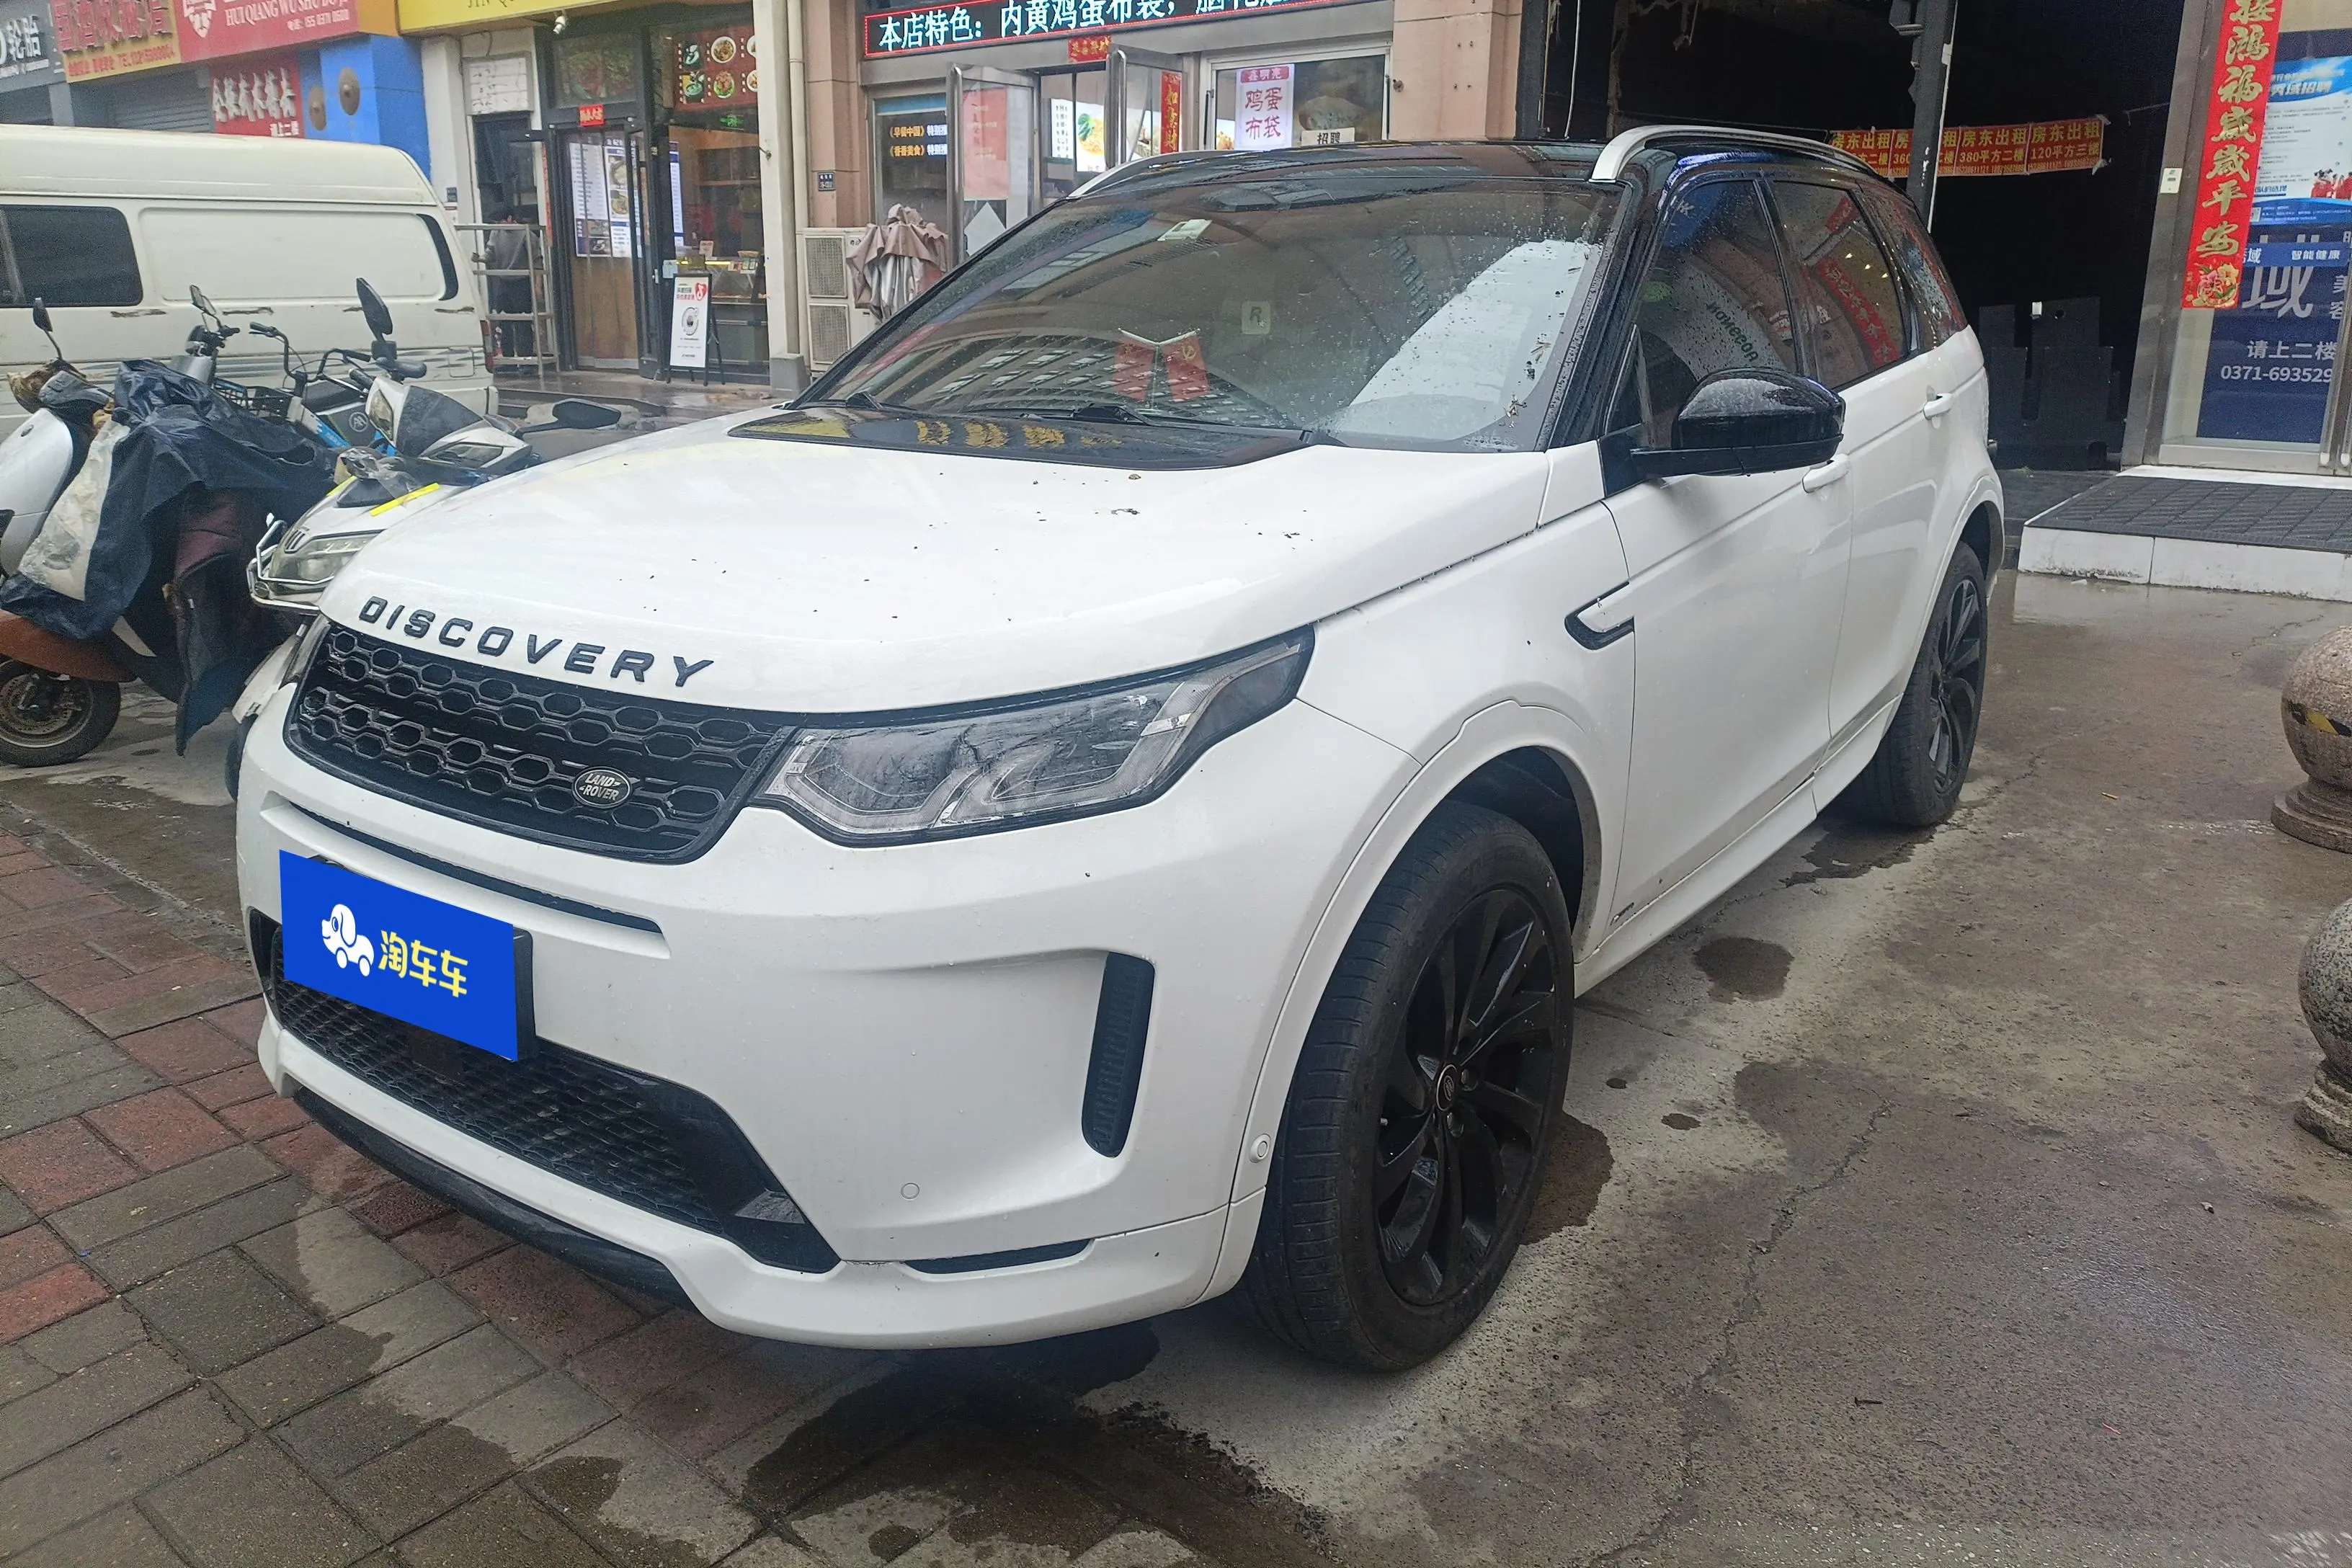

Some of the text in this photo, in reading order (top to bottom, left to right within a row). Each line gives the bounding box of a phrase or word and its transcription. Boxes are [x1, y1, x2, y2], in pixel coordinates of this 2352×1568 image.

[1245, 86, 1283, 112] 鸡蛋
[1245, 115, 1282, 140] 布袋
[2031, 121, 2100, 143] 房东出租
[1317, 132, 1340, 144] 招聘
[1832, 131, 1891, 150] 房东出租
[1961, 128, 2028, 147] 房东出租
[1959, 147, 2024, 163] 380平方二楼
[2031, 141, 2100, 160] 120平方三楼
[2291, 249, 2340, 260] 智能健康
[2247, 340, 2338, 360] 请上二楼
[359, 595, 714, 687] DISCOVERY
[585, 773, 615, 787] LAND
[583, 785, 619, 801] ROVER
